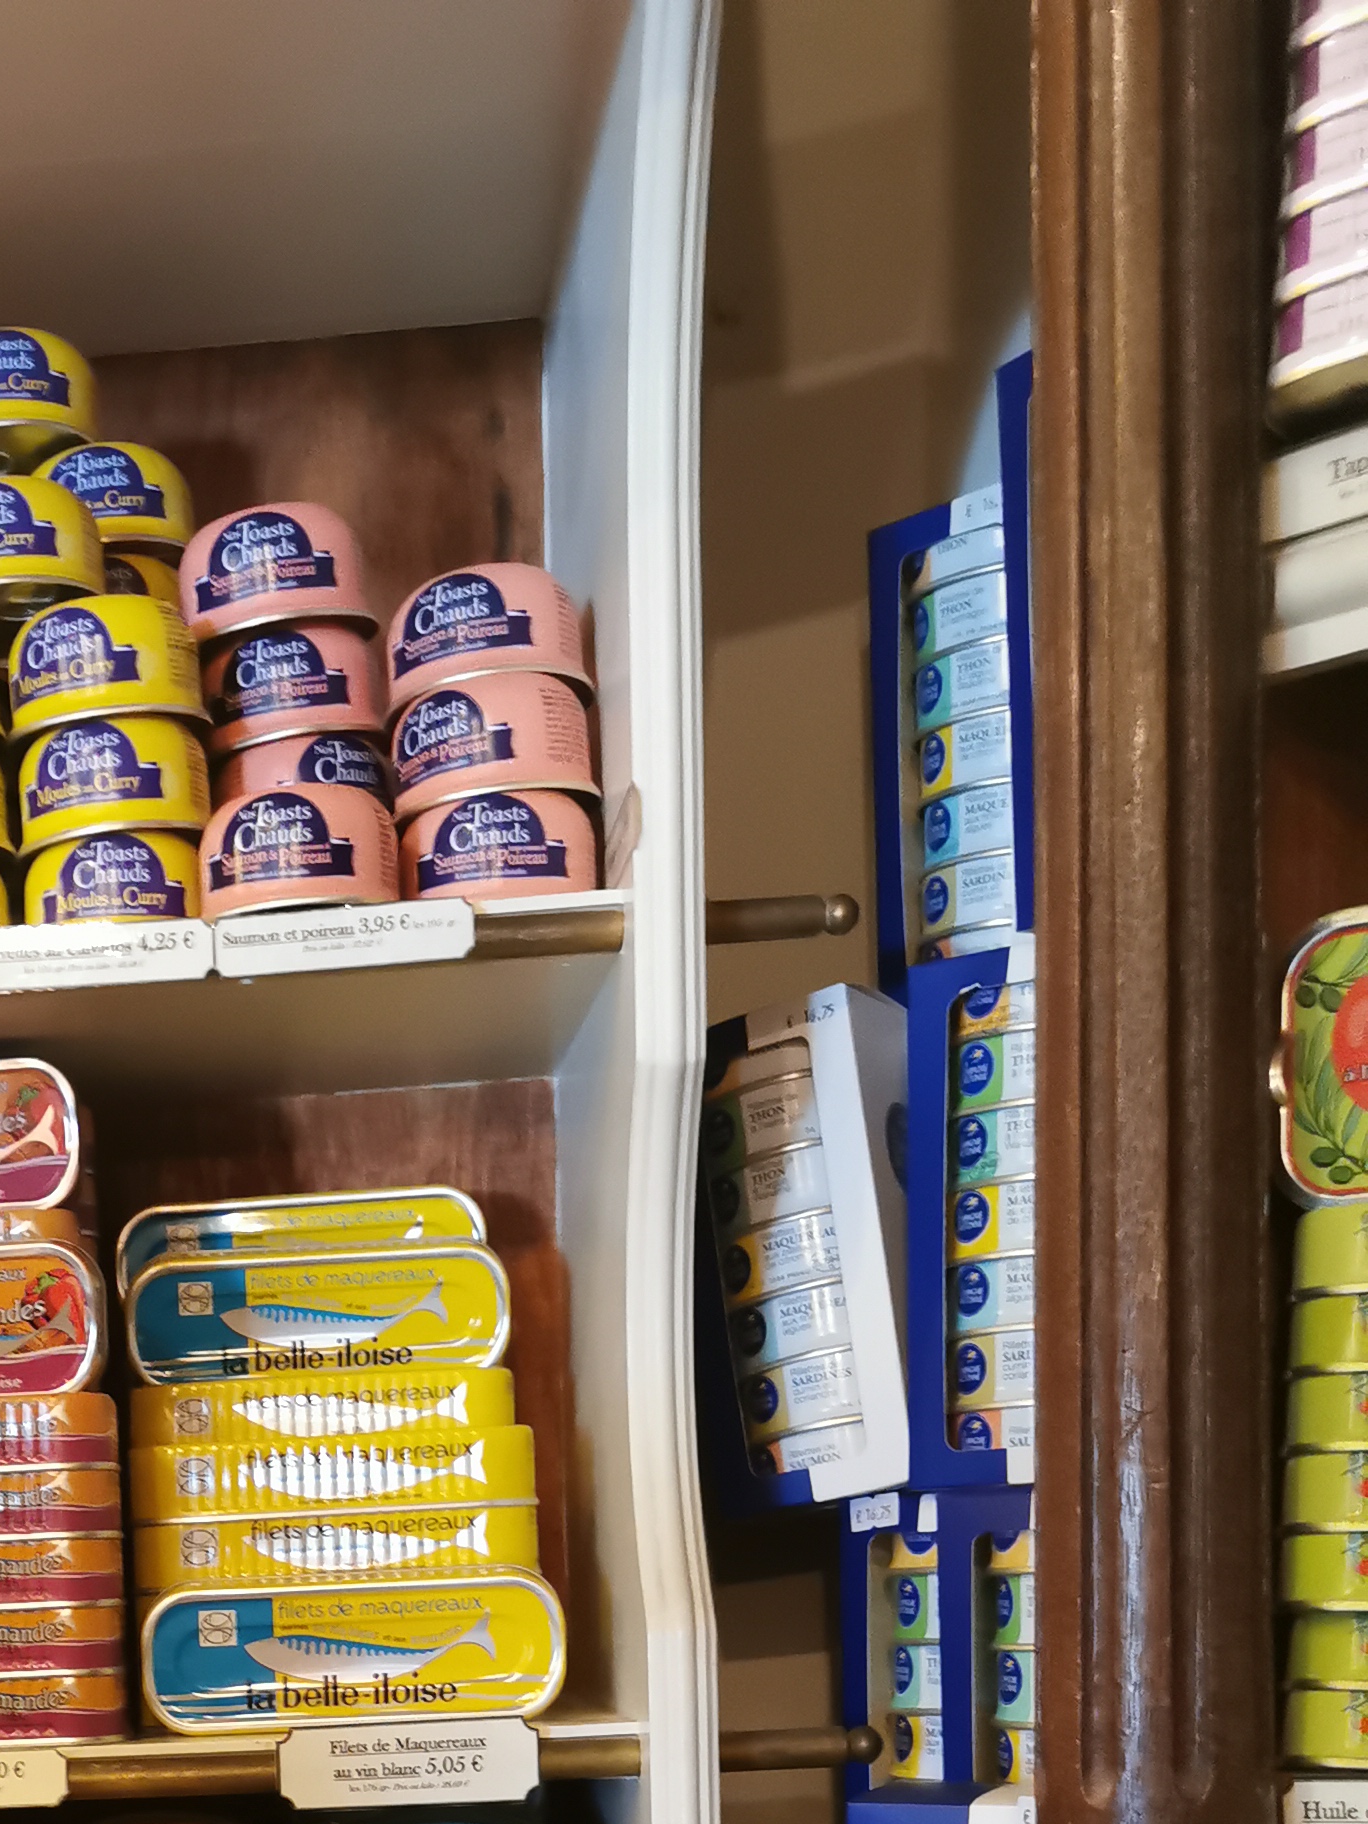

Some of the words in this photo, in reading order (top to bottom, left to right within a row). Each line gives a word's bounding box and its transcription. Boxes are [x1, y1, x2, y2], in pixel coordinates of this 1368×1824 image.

[7, 373, 50, 395] Curry
[73, 452, 128, 475] Toasts
[56, 471, 131, 496] Chauds
[103, 491, 146, 510] Curry
[236, 519, 295, 544] Toasts
[221, 540, 298, 572] Chauds
[432, 581, 488, 607] Toasts
[414, 601, 490, 634] Chauds
[64, 728, 121, 754] Toasts
[47, 751, 122, 780] Chauds
[93, 772, 141, 794] Curry
[255, 798, 313, 825] Toasts
[470, 802, 530, 826] Toasts
[234, 824, 314, 853] Chauds
[449, 824, 531, 853] Chauds
[91, 840, 150, 865] Toasts
[73, 863, 151, 889] Chauds
[123, 887, 168, 909] Curry
[182, 930, 195, 950] €
[222, 930, 281, 948] Saumon
[301, 924, 355, 946] poireau
[359, 915, 395, 936] 3,95
[399, 913, 410, 930] €
[250, 1271, 293, 1290] filets
[296, 1272, 318, 1287] de
[323, 1266, 436, 1288] maquereaux
[254, 1337, 413, 1372] belle-iloise
[250, 1520, 302, 1542] filets
[307, 1520, 335, 1539] de
[340, 1513, 478, 1541] maquereaux
[278, 1601, 325, 1620] filets
[328, 1600, 354, 1617] de
[358, 1595, 483, 1620] maquereaux
[245, 1679, 275, 1711] la
[282, 1671, 457, 1709] belle-iloise
[329, 1739, 368, 1756] Filets
[372, 1738, 389, 1752] de
[394, 1734, 488, 1752] Maquereaux
[13, 1761, 26, 1779] €
[333, 1768, 352, 1779] au
[355, 1764, 377, 1779] vin
[381, 1762, 422, 1778] blanc
[425, 1756, 465, 1775] 5,05
[470, 1754, 484, 1773] €
[1302, 1800, 1359, 1821] Huile
